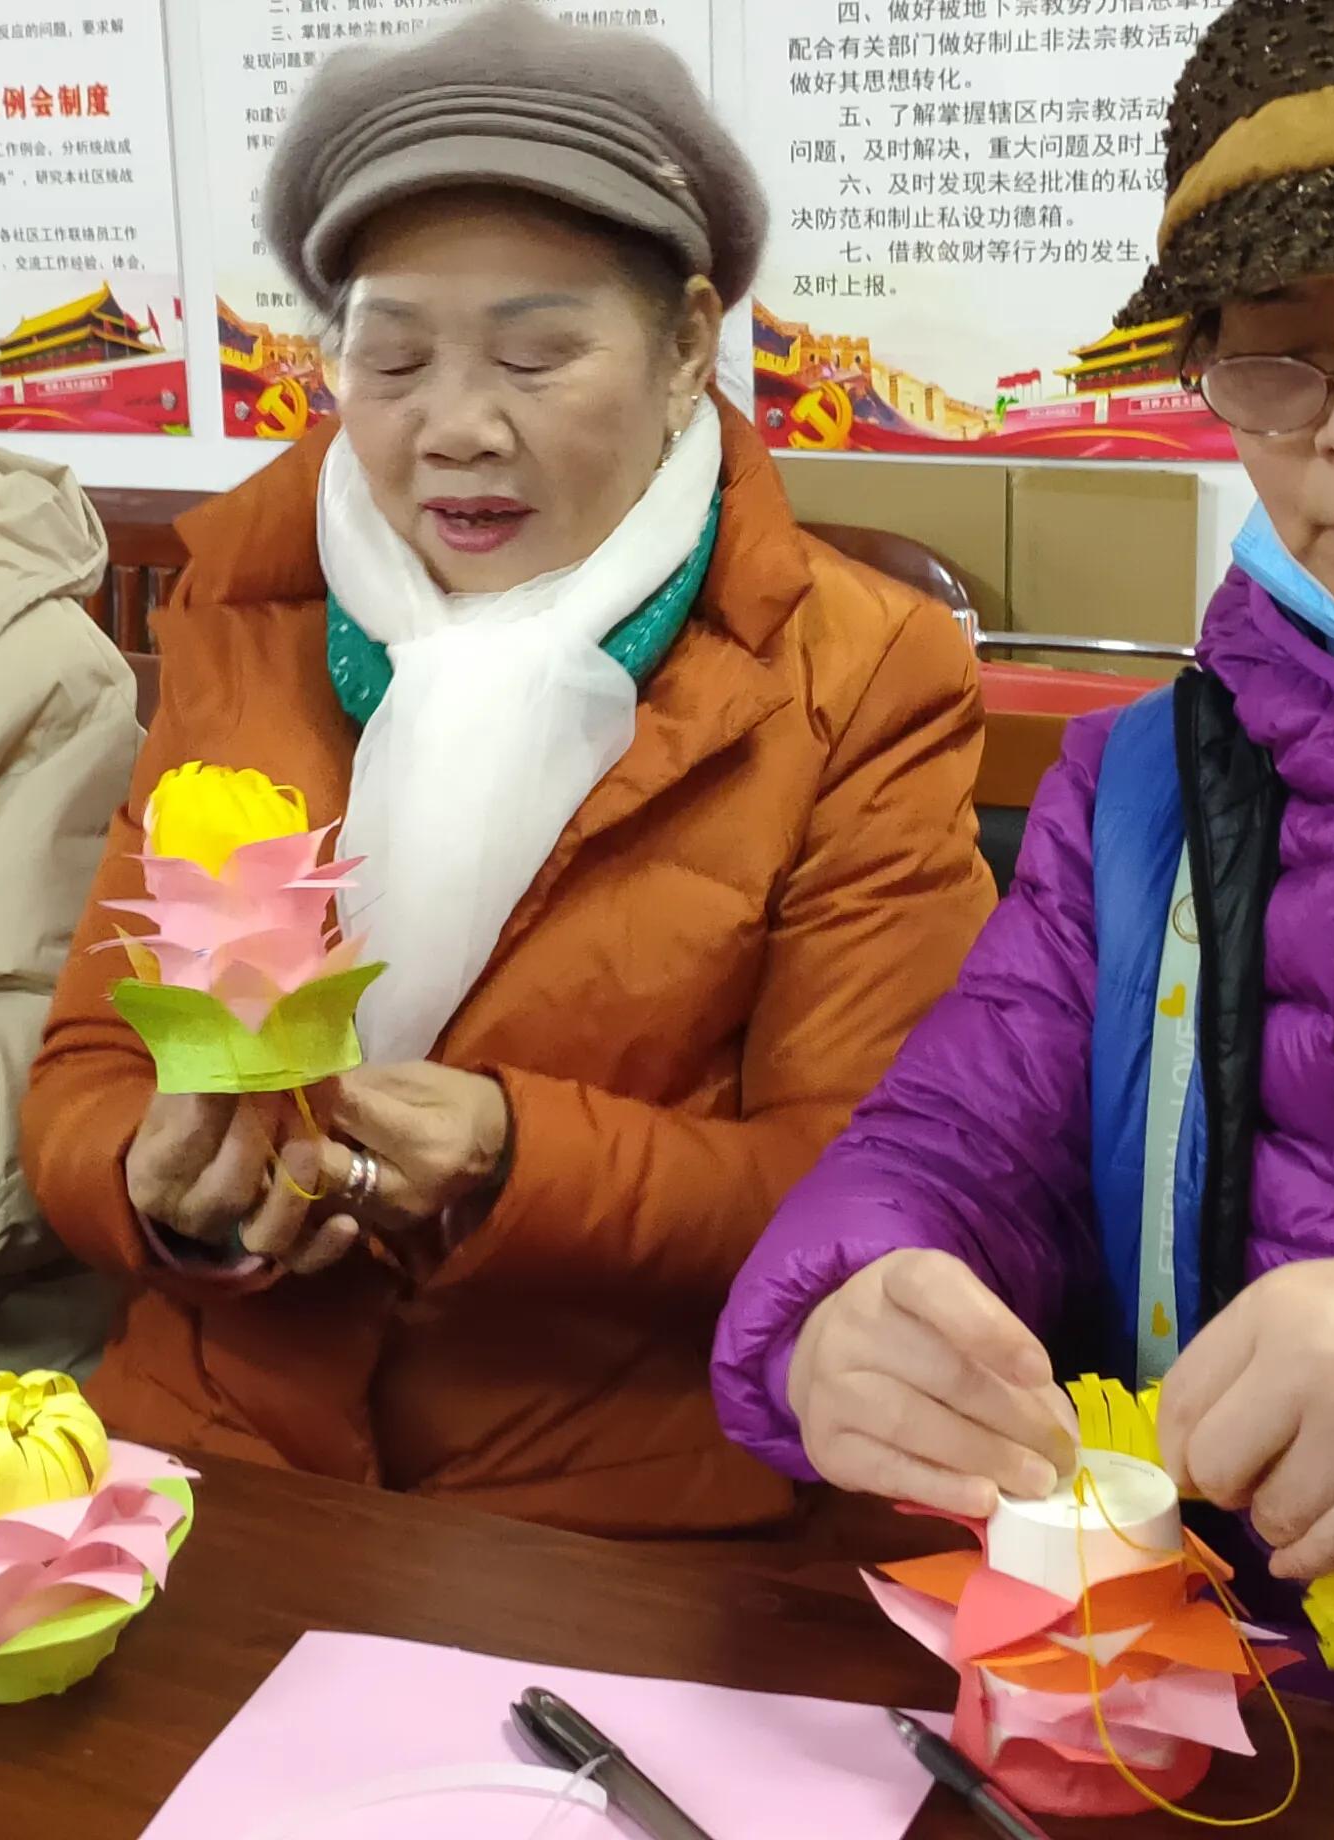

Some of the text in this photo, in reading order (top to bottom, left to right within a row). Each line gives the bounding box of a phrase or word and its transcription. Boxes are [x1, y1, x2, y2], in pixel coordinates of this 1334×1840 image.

[789, 69, 973, 97] 做好其思想转化。
[790, 203, 1074, 231] 决防范和制止私设功德箱。
[792, 274, 897, 298] 及时上报。
